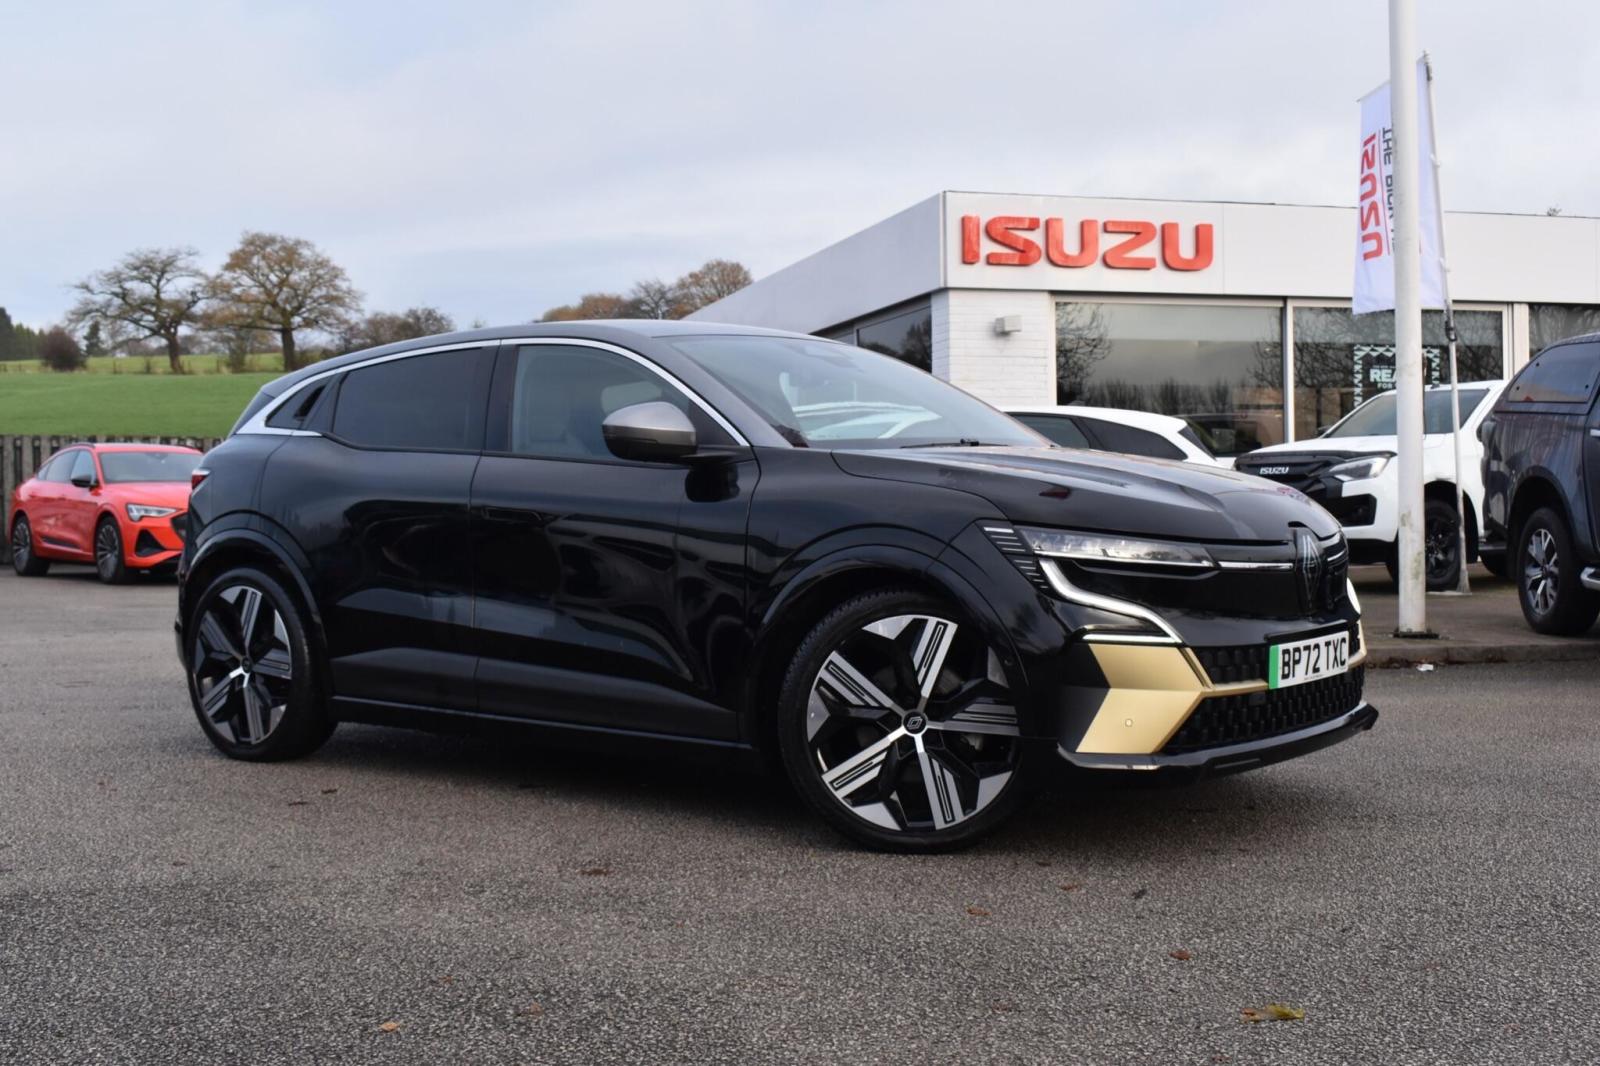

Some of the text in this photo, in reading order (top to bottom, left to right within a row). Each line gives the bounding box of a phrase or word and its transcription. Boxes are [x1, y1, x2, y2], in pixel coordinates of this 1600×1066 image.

[961, 215, 1214, 271] ISUZU
[1259, 466, 1289, 475] ISUZU
[1281, 637, 1347, 680] BP72 TXC
